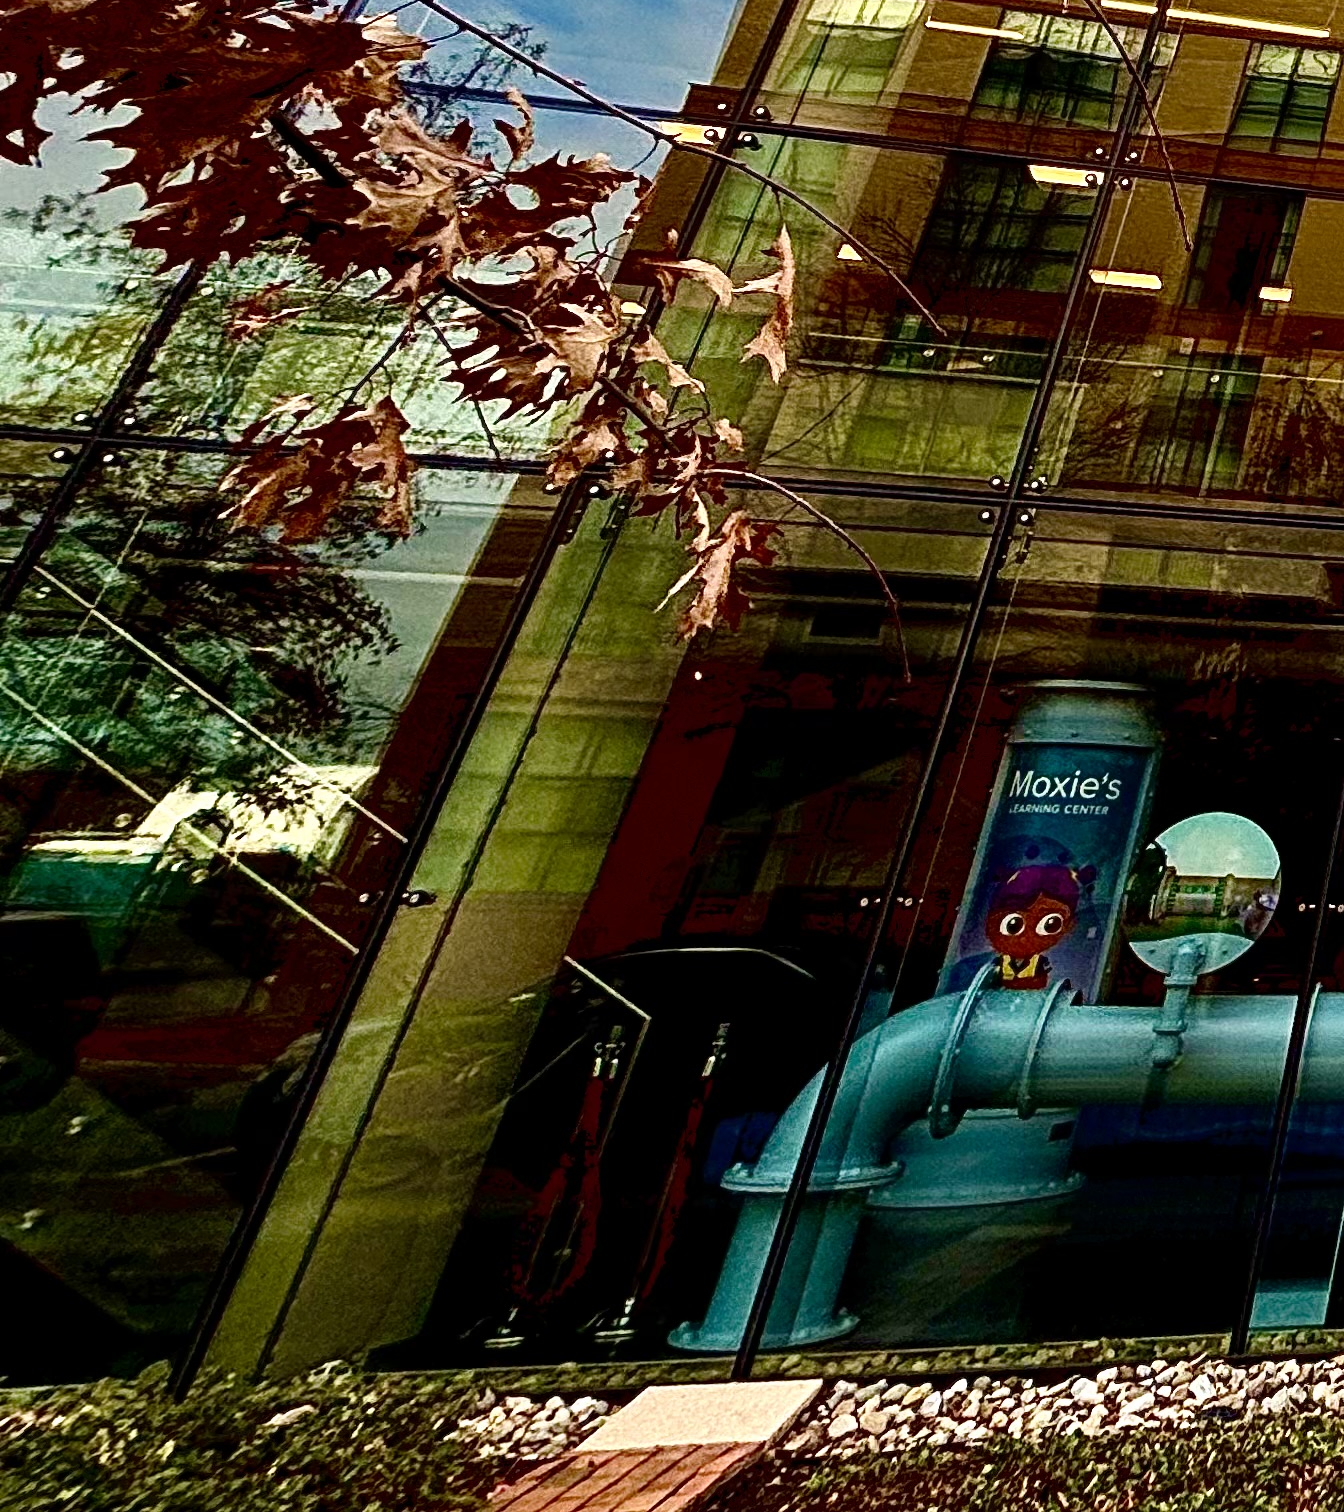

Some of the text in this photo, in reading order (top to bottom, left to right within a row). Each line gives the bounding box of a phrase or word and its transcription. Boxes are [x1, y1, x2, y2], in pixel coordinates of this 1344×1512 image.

[1008, 770, 1122, 800] Moxie's
[1008, 803, 1109, 815] LEARNING CENTER
